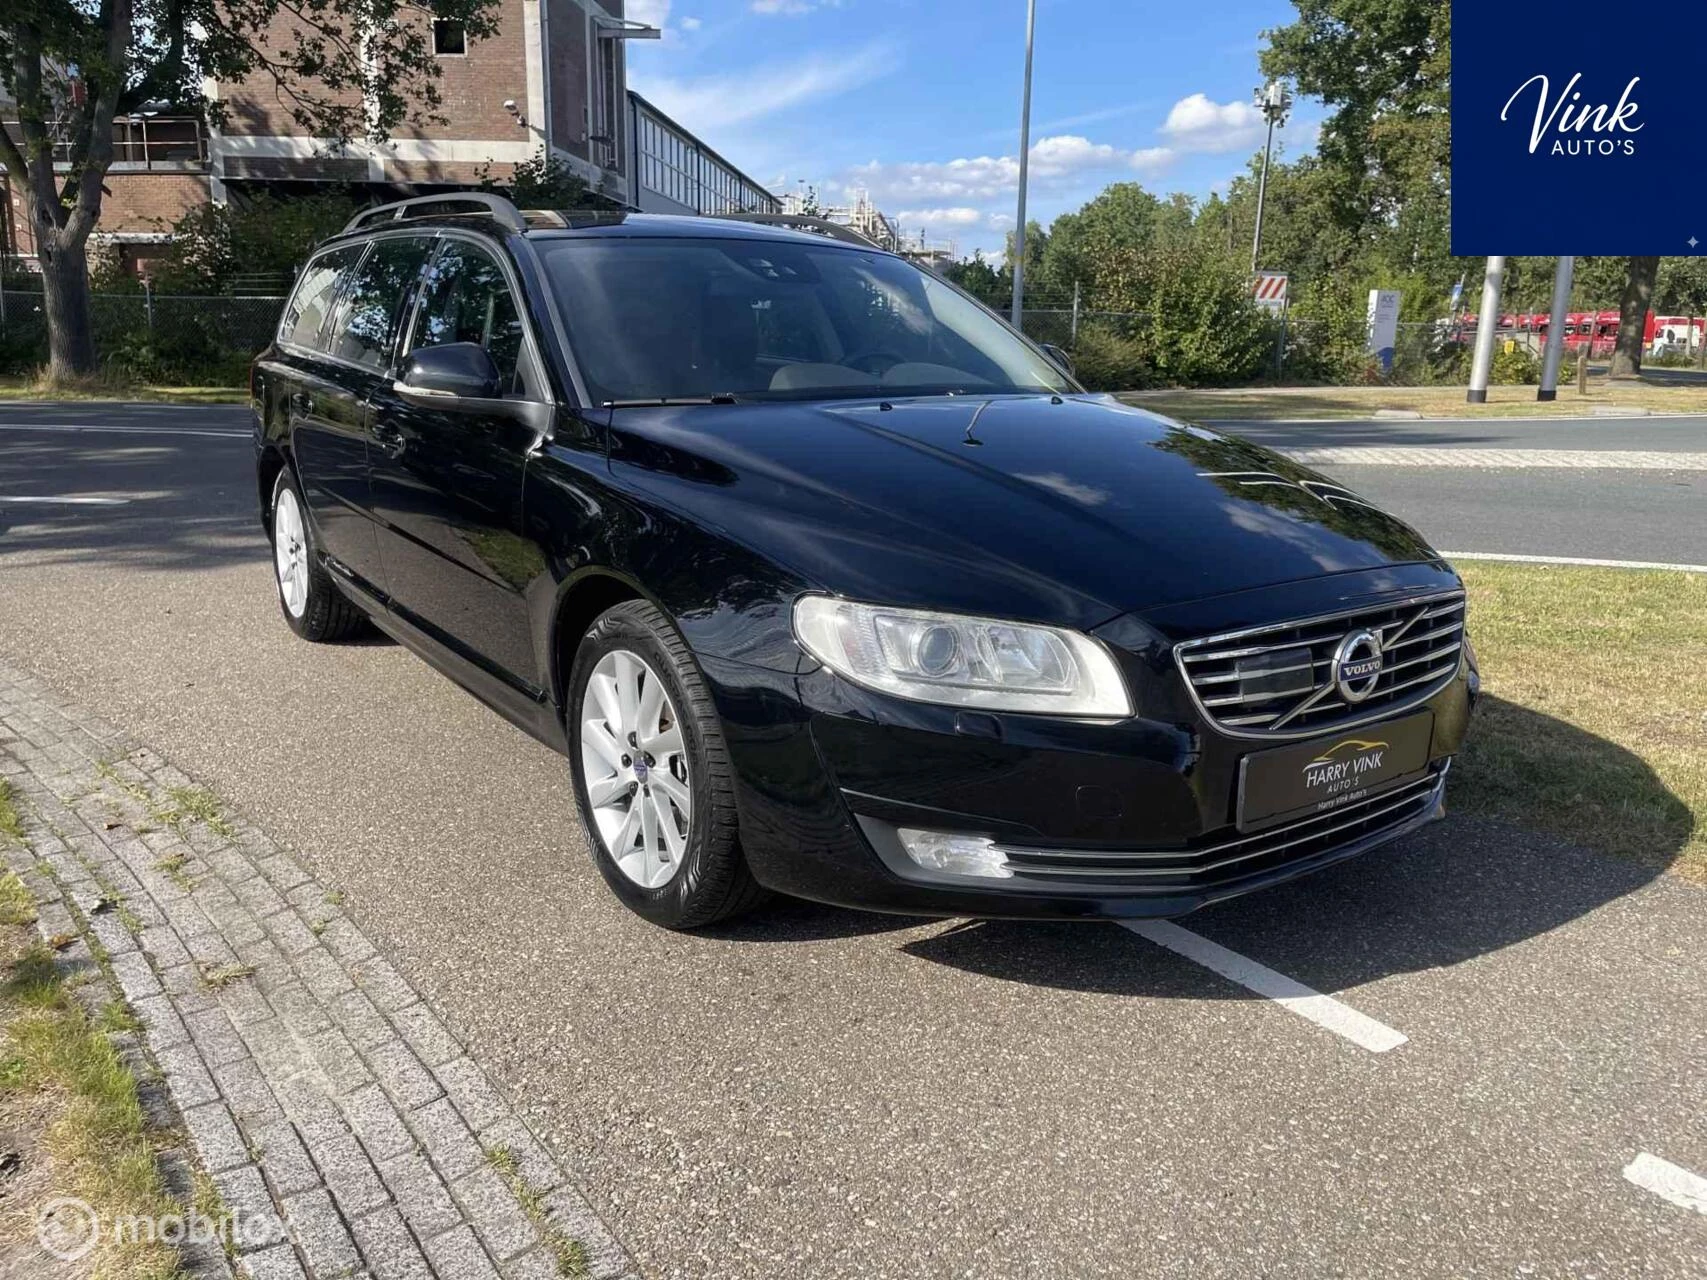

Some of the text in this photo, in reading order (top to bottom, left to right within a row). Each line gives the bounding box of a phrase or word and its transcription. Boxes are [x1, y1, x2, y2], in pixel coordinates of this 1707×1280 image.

[1343, 660, 1381, 676] VOLVO
[1306, 751, 1384, 789] HARRY VINK
